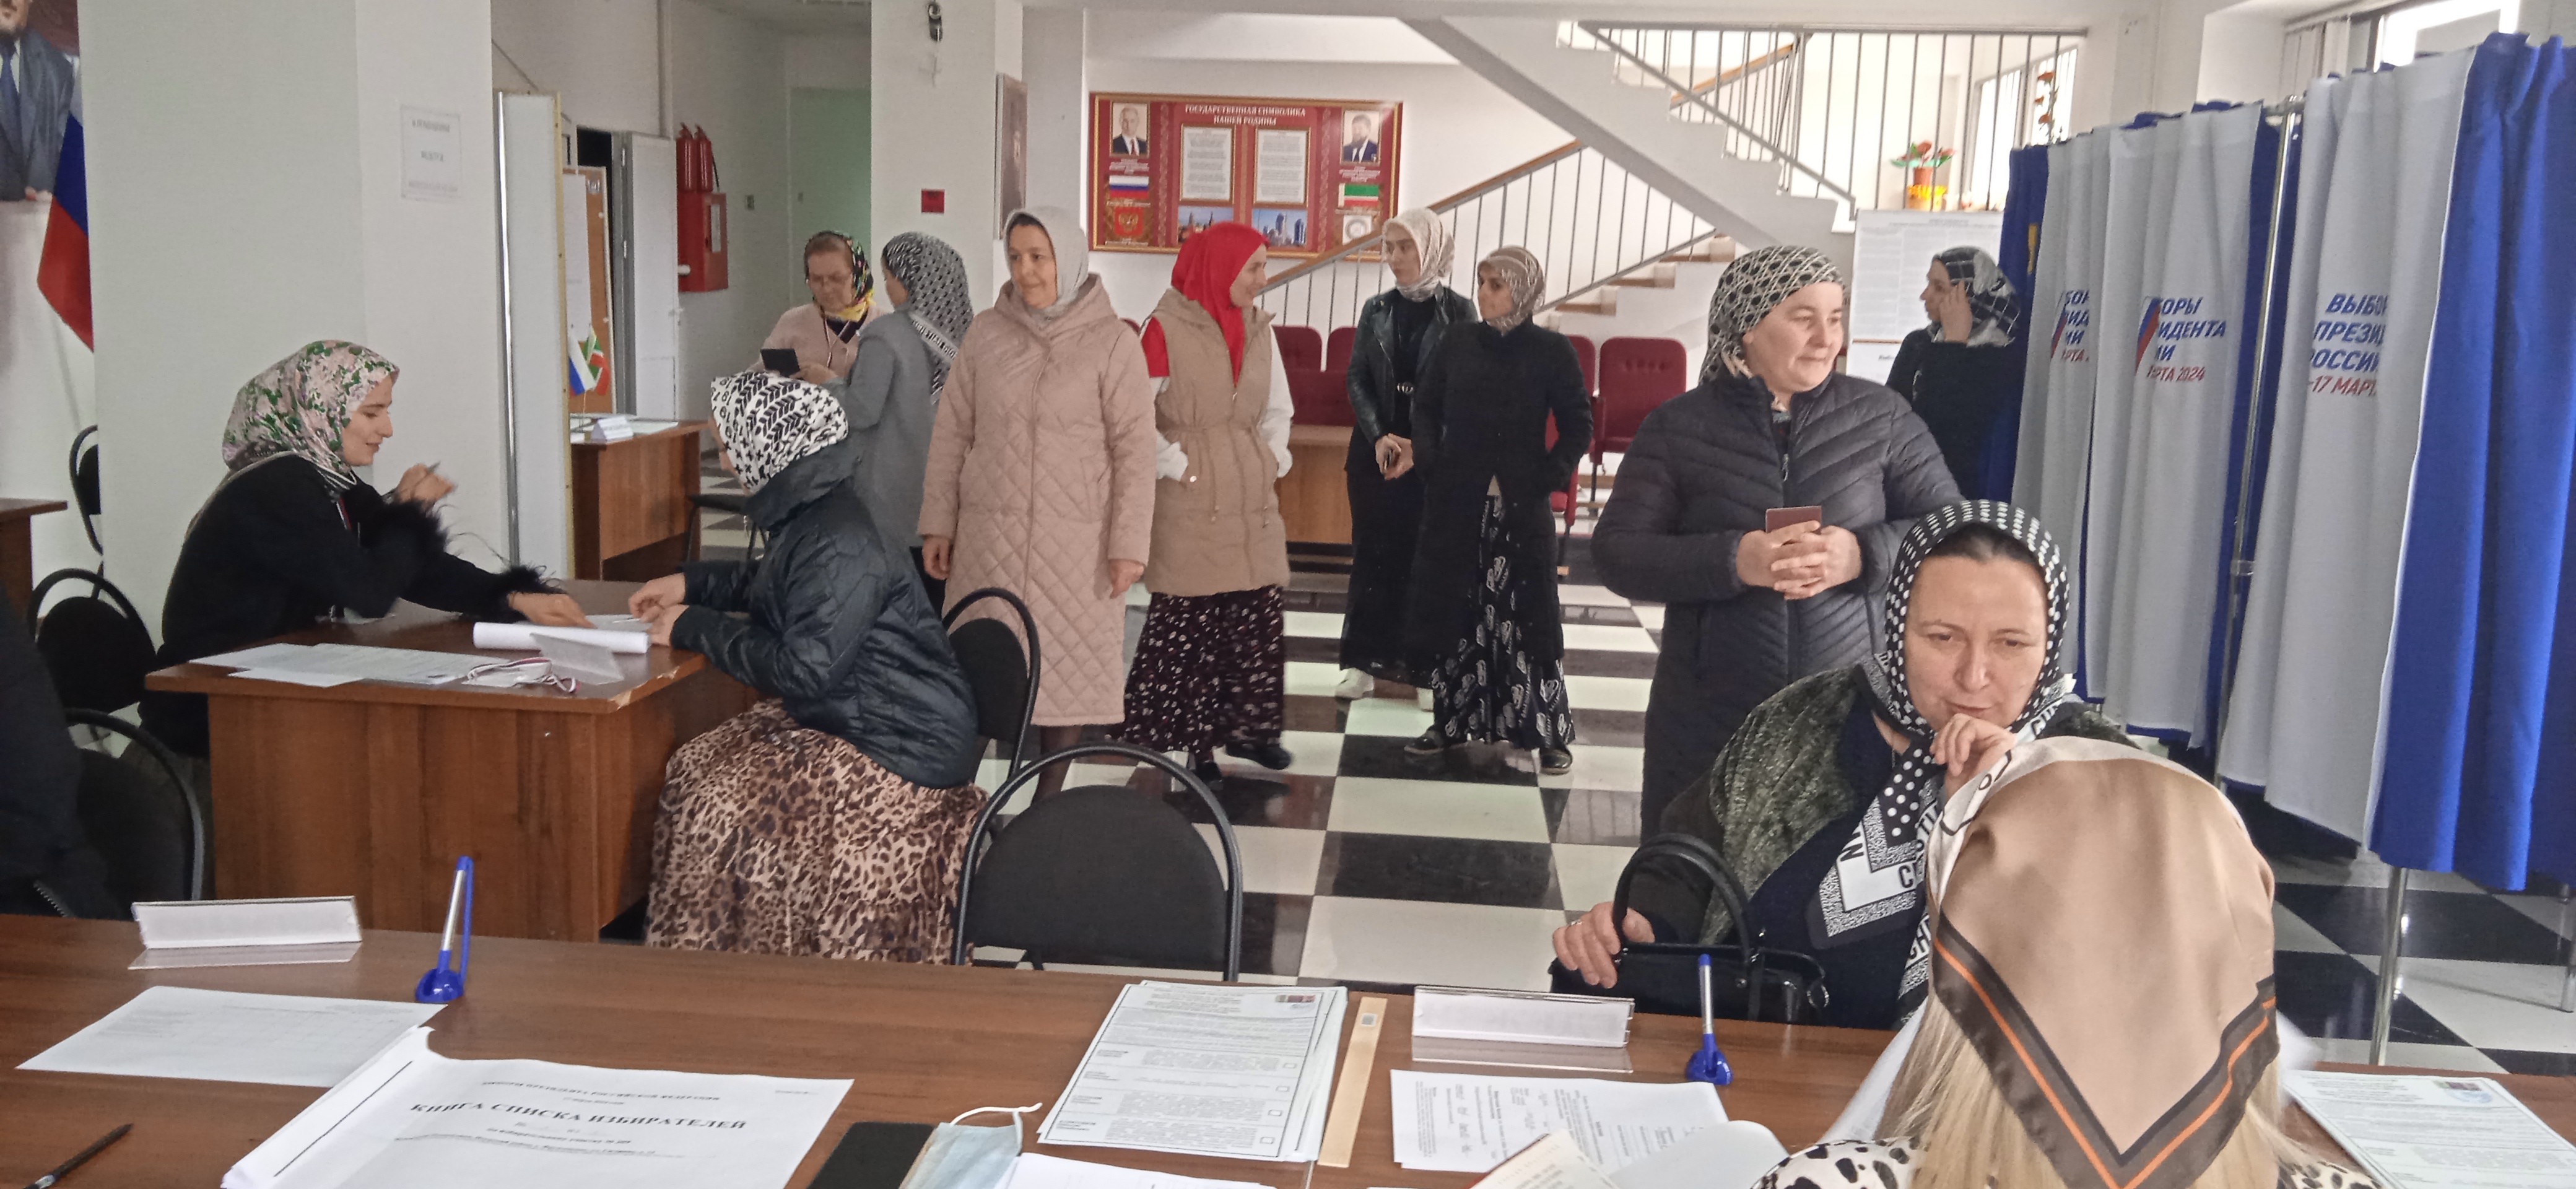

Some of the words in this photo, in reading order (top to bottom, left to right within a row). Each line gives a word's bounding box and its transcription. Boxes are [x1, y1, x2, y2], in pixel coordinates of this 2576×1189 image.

[2159, 297, 2204, 315] ОРЫ
[2157, 320, 2227, 341] ИДЕНТА
[411, 1102, 483, 1113] КНИГА
[490, 1104, 581, 1121] СПИСКА
[588, 1115, 747, 1129] ИЗБИРАТЕЛЕЙ
